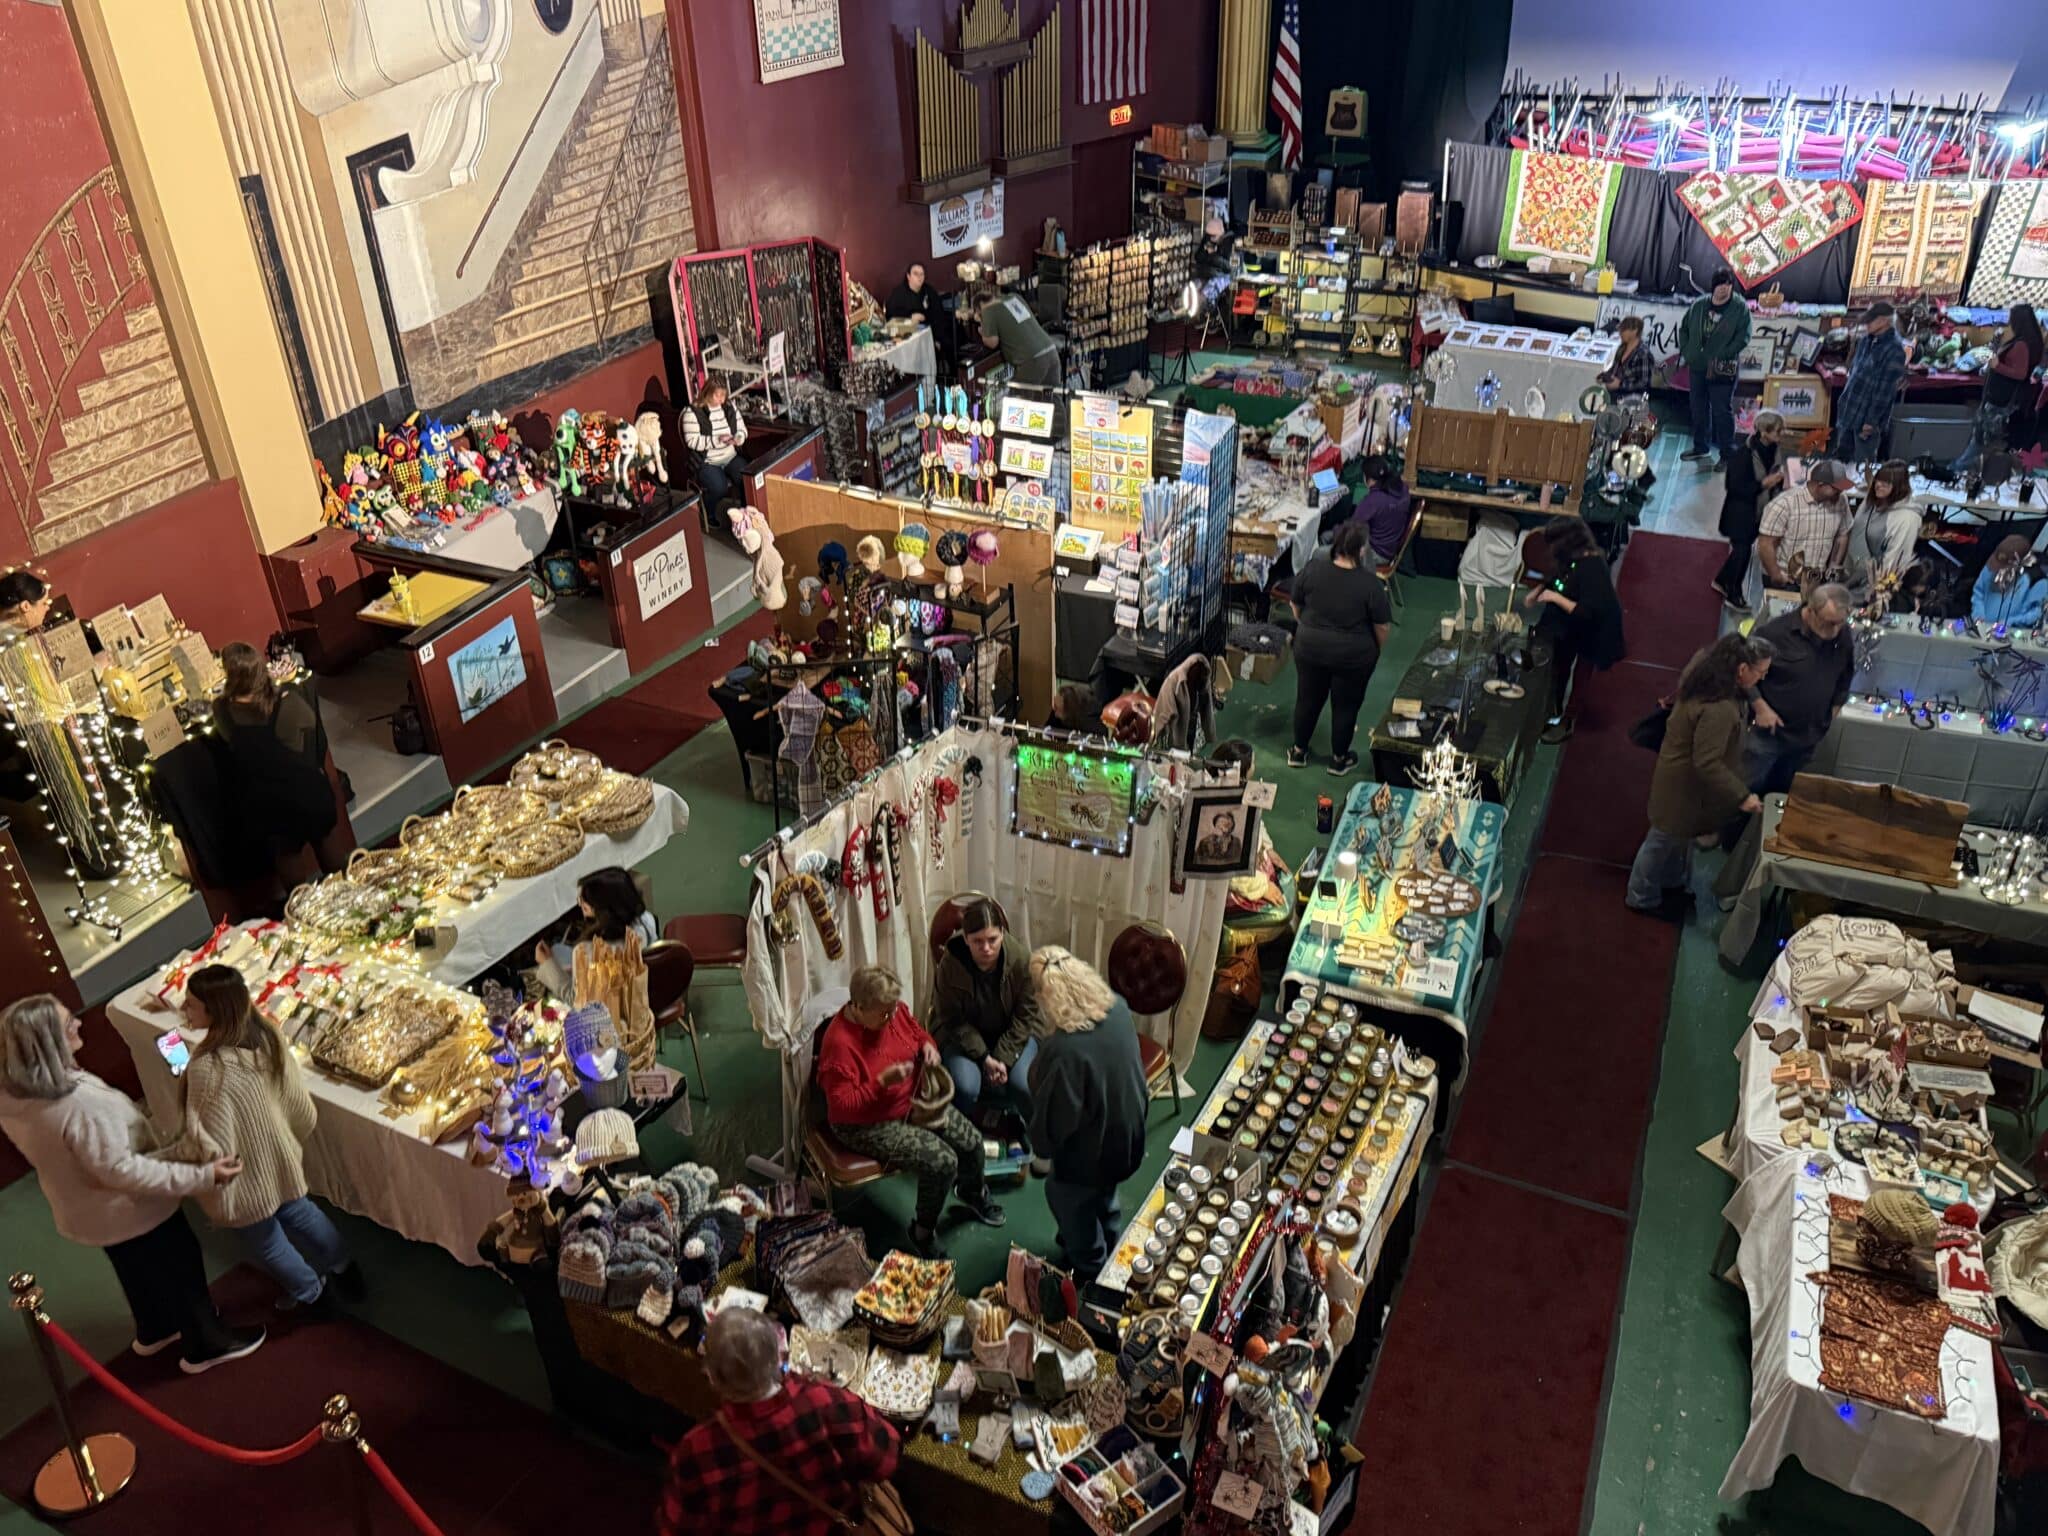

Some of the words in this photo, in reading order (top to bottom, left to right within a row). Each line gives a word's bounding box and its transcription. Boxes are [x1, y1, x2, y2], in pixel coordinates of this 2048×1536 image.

[1113, 109, 1128, 122] EXIT
[938, 206, 970, 225] WILLIAMS
[639, 564, 655, 591] The
[653, 552, 684, 589] Pines
[649, 578, 684, 608] WINERY
[421, 646, 433, 660] 12
